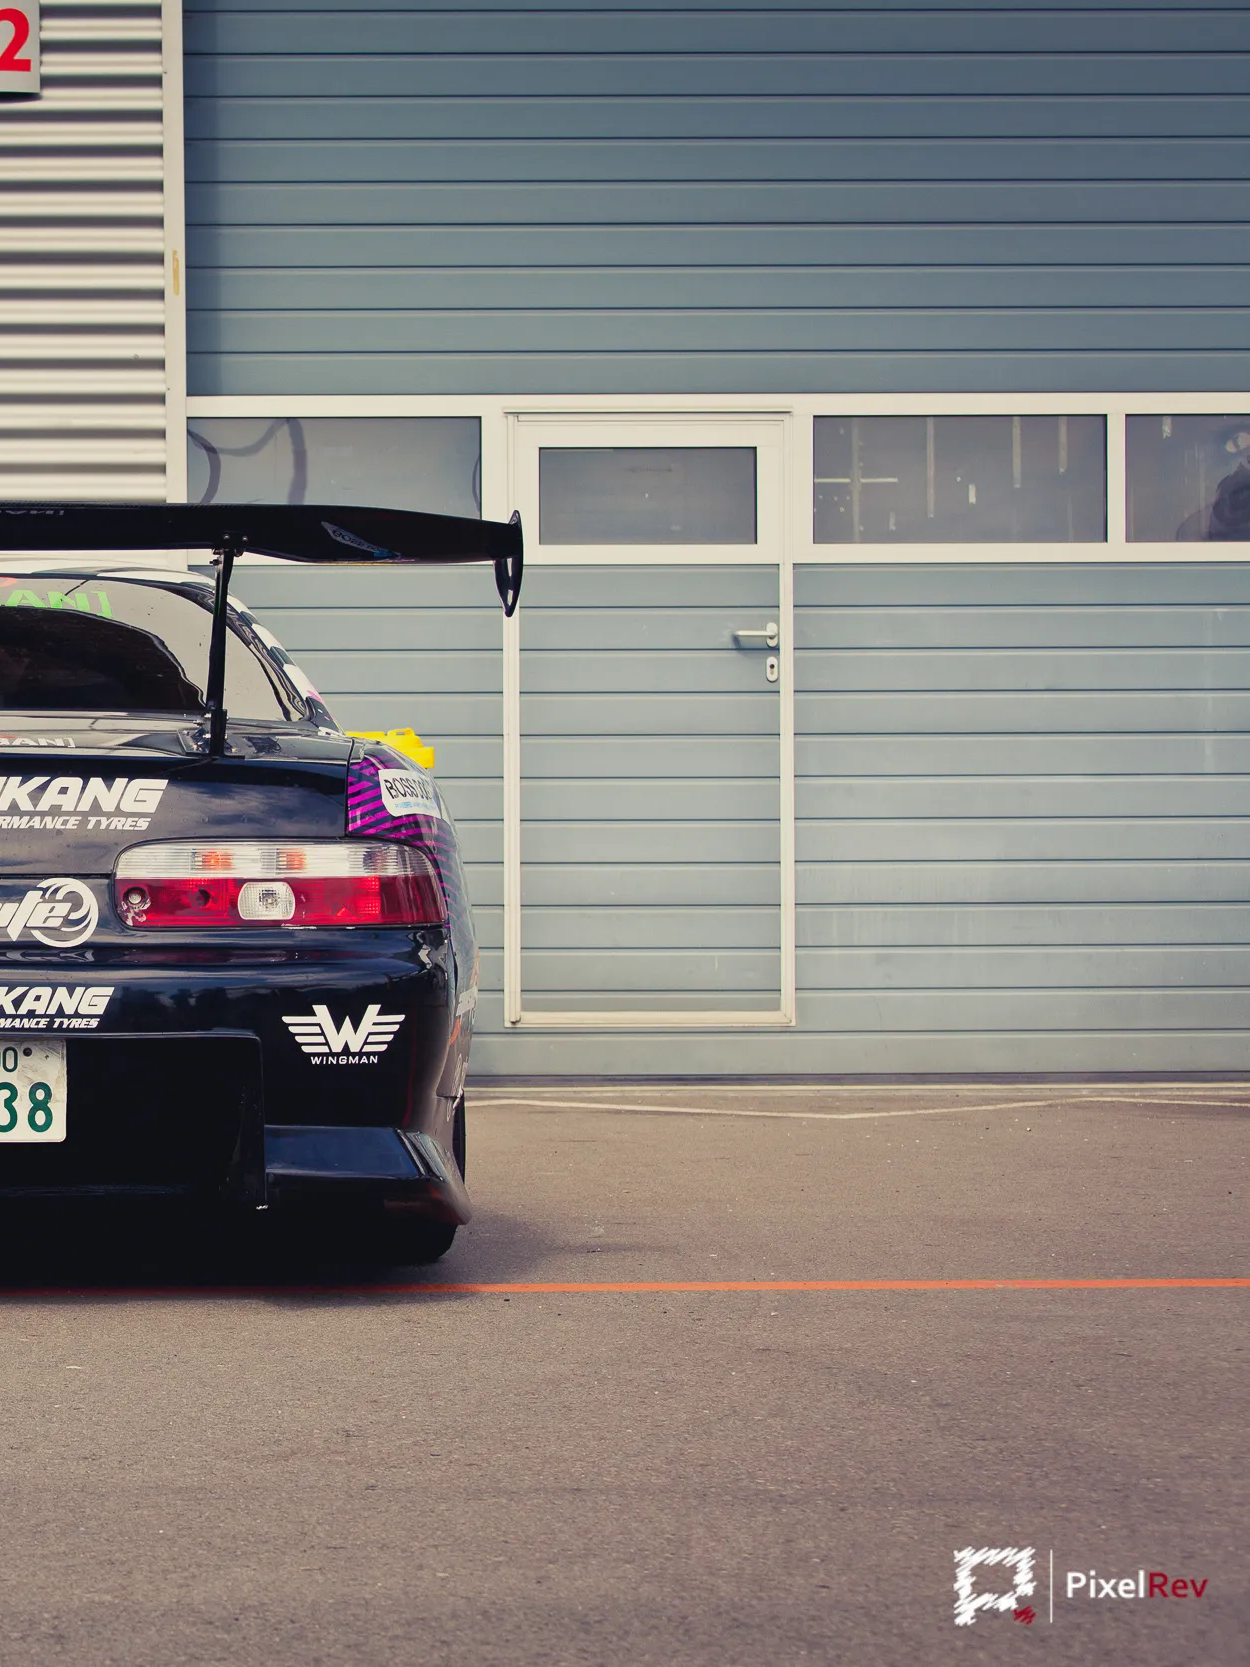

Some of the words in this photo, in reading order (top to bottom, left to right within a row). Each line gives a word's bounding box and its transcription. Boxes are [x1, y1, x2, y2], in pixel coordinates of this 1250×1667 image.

[86, 816, 151, 831] TYRES
[53, 1017, 100, 1029] TYRES
[310, 1055, 379, 1065] WINGMAN
